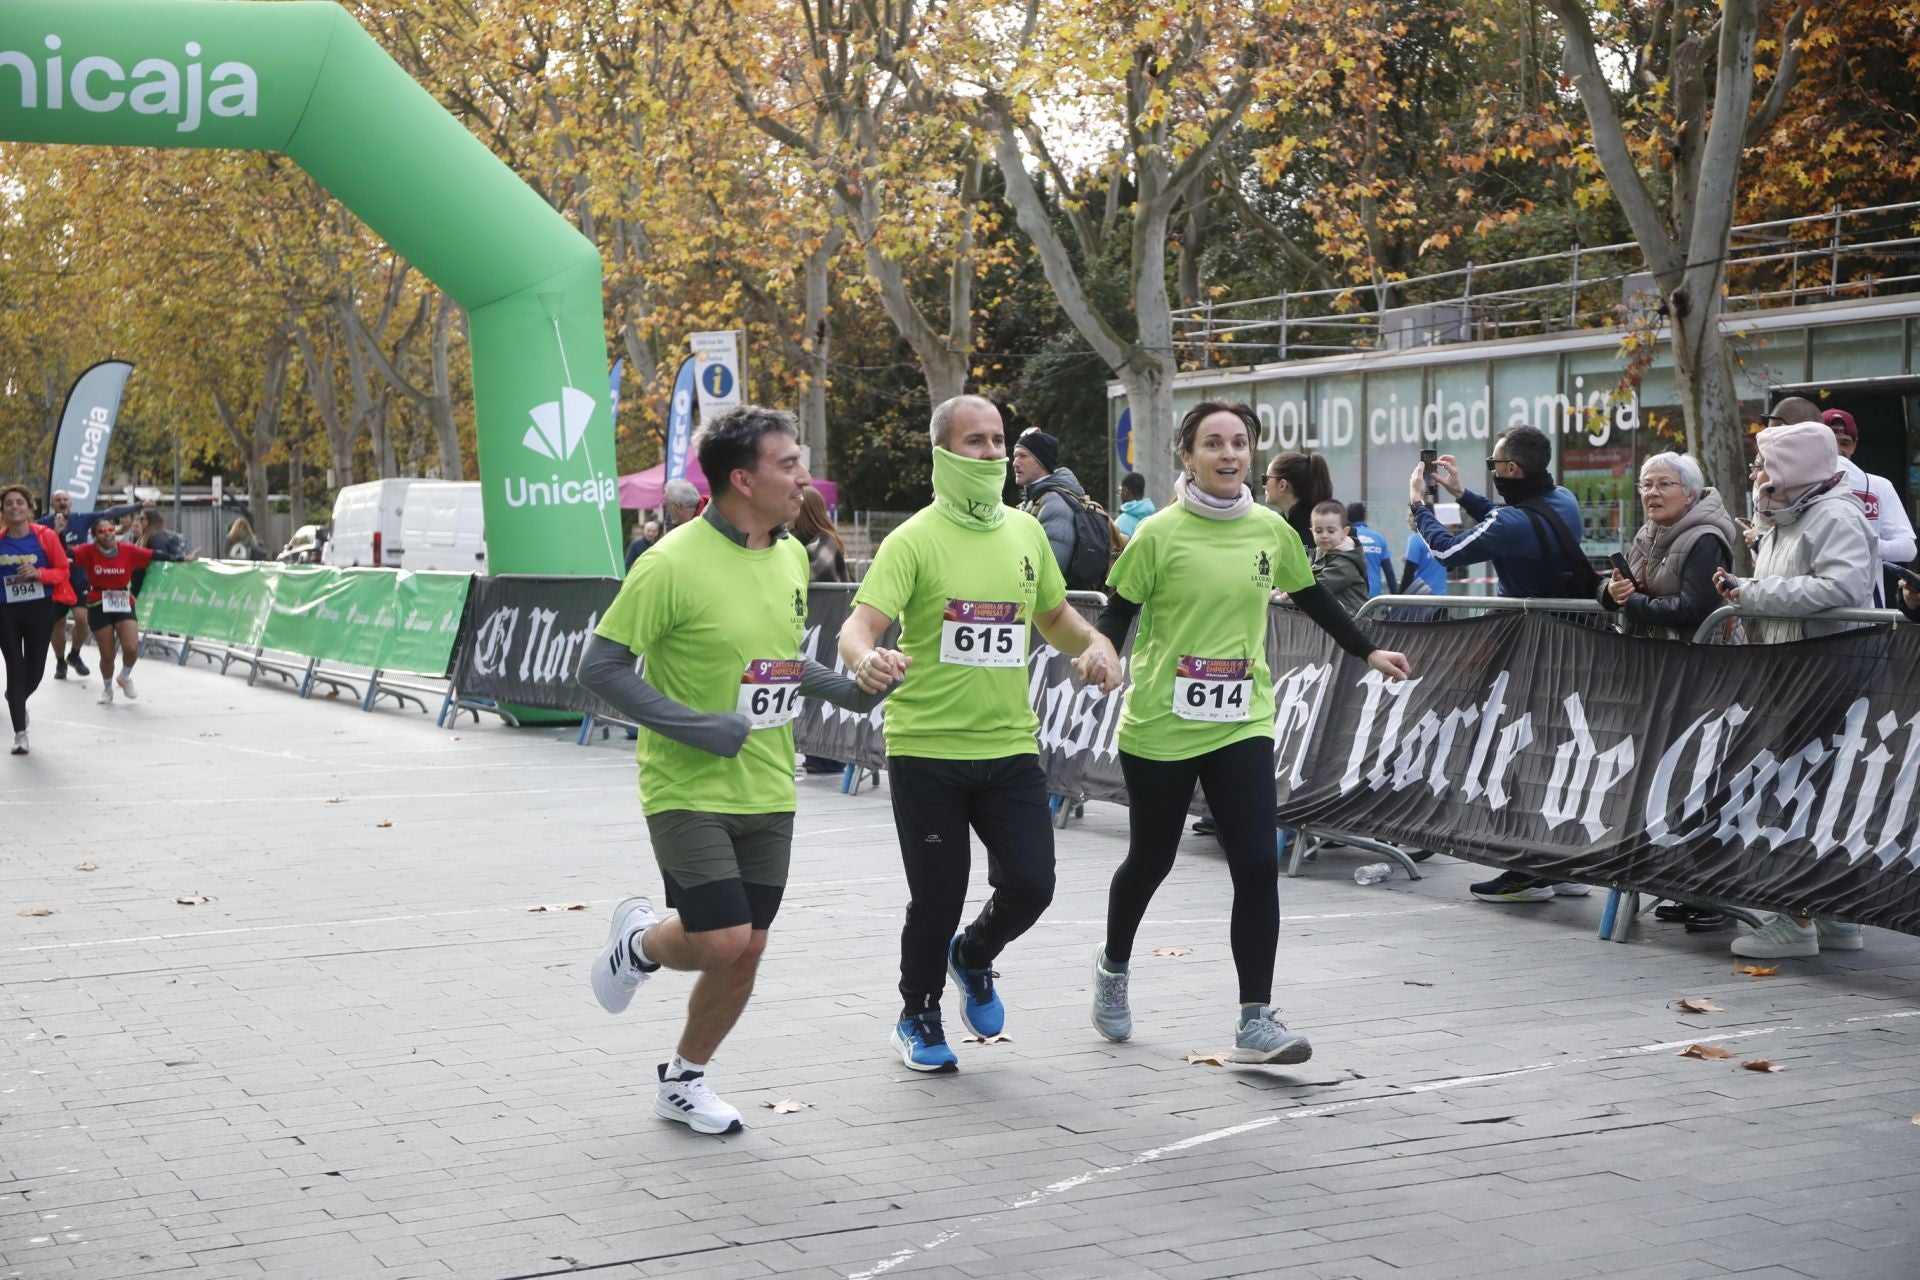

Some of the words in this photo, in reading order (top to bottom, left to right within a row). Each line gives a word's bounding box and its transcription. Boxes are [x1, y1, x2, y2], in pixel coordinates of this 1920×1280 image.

[0, 34, 258, 132] nicaja
[1256, 396, 1354, 451] DOLID
[1370, 384, 1490, 446] ciudad
[1508, 376, 1640, 447] amiga
[671, 389, 690, 478] VECO
[69, 405, 110, 500] Unicaja
[504, 471, 616, 511] Unicaja
[1864, 502, 1878, 515] OS
[12, 583, 36, 596] 994
[973, 609, 1004, 617] EMPRESAS
[474, 605, 520, 678] El
[518, 606, 597, 684] Nort
[954, 626, 1013, 654] 615
[771, 668, 800, 676] EMPRESAS
[1206, 666, 1236, 674] EMPRESAS
[1186, 682, 1243, 709] 614
[1339, 669, 1534, 812] Norte
[1539, 691, 1635, 844] de
[1645, 696, 1920, 874] Castil
